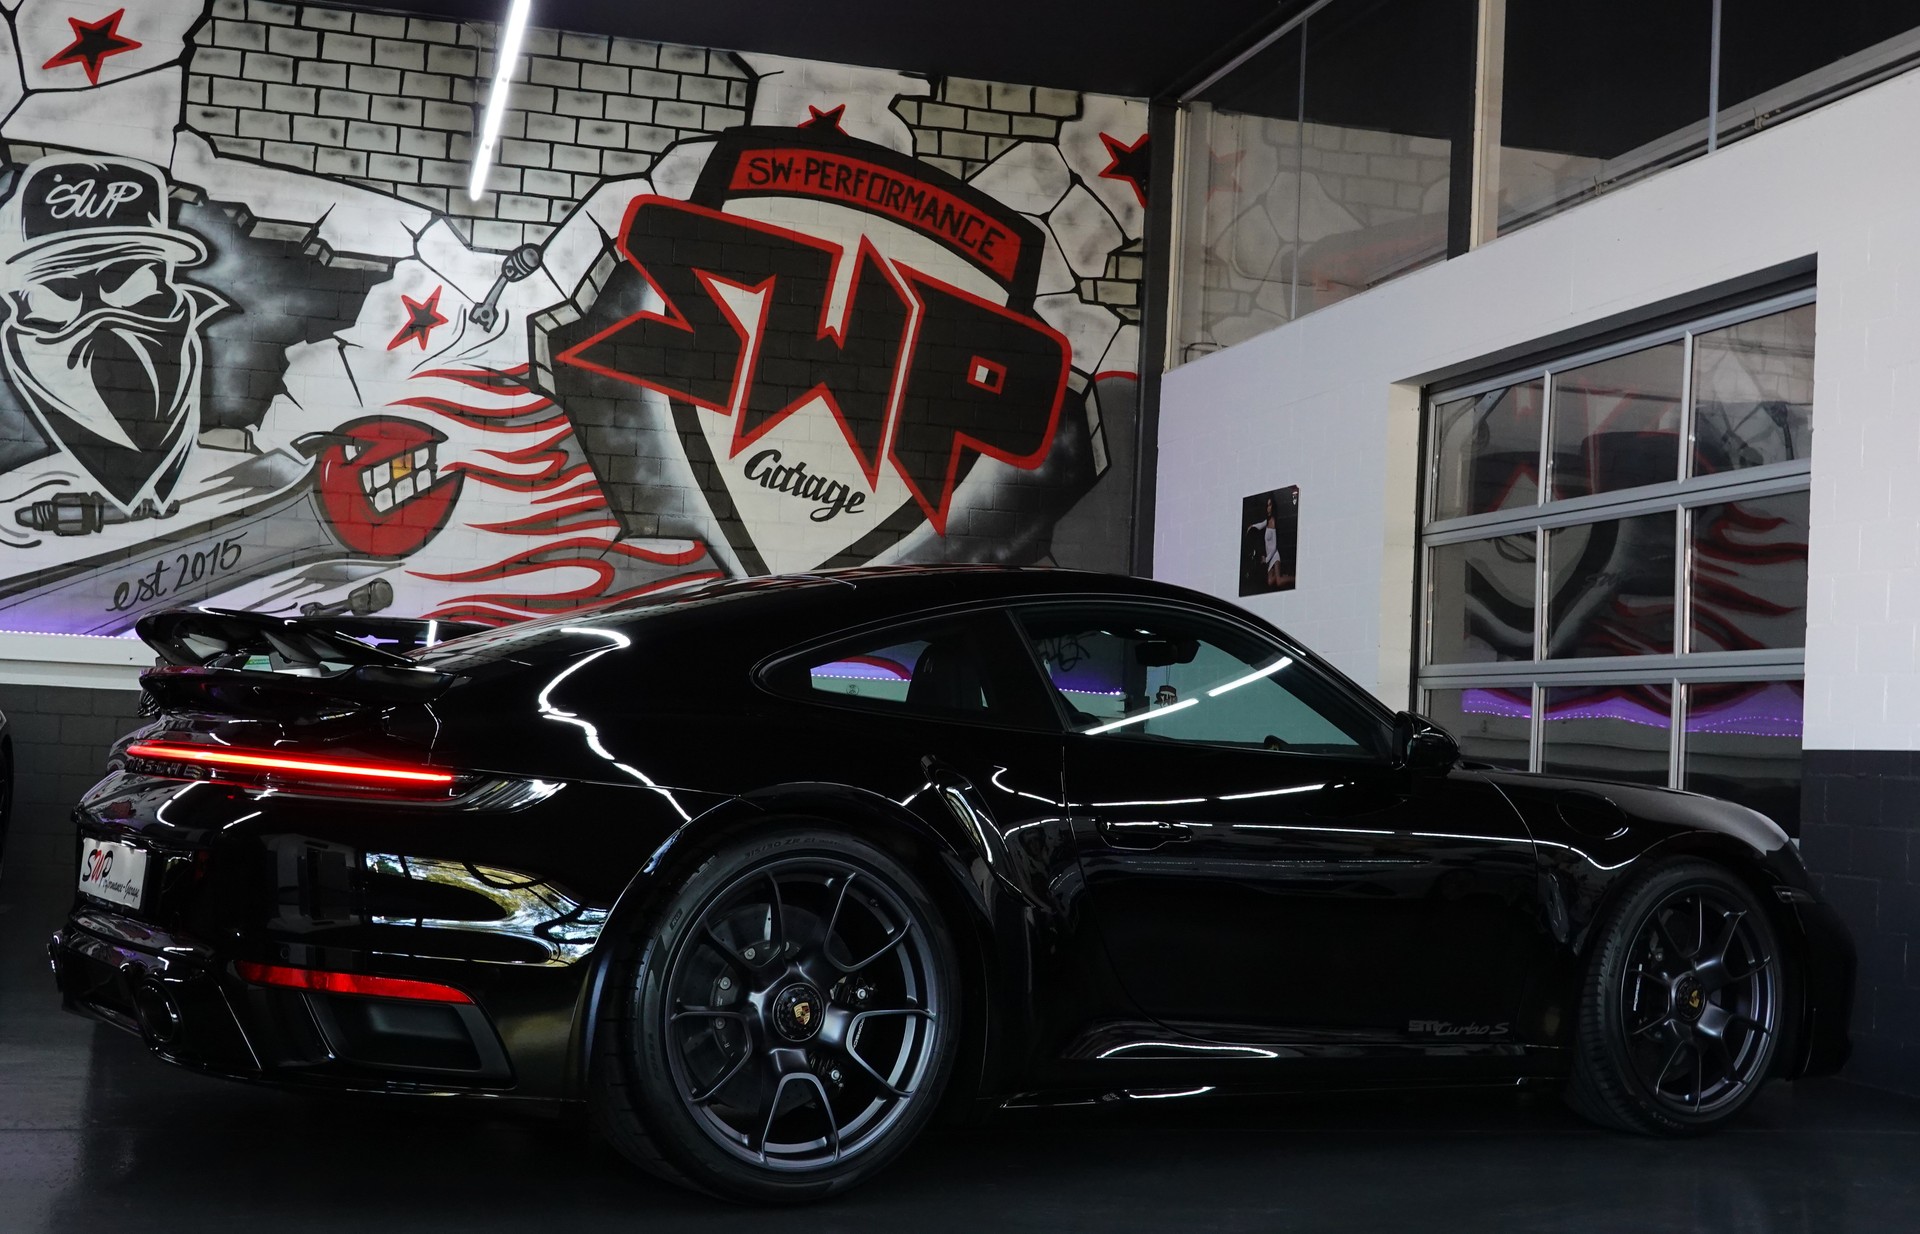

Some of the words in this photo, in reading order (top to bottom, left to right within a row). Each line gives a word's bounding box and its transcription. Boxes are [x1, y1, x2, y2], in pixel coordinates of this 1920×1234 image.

[45, 178, 144, 219] SWP
[748, 156, 1006, 262] SW-PERFORMANCE
[555, 194, 1072, 538] SWP
[744, 449, 866, 522] Garage
[105, 560, 171, 611] est
[173, 531, 248, 592] 2015
